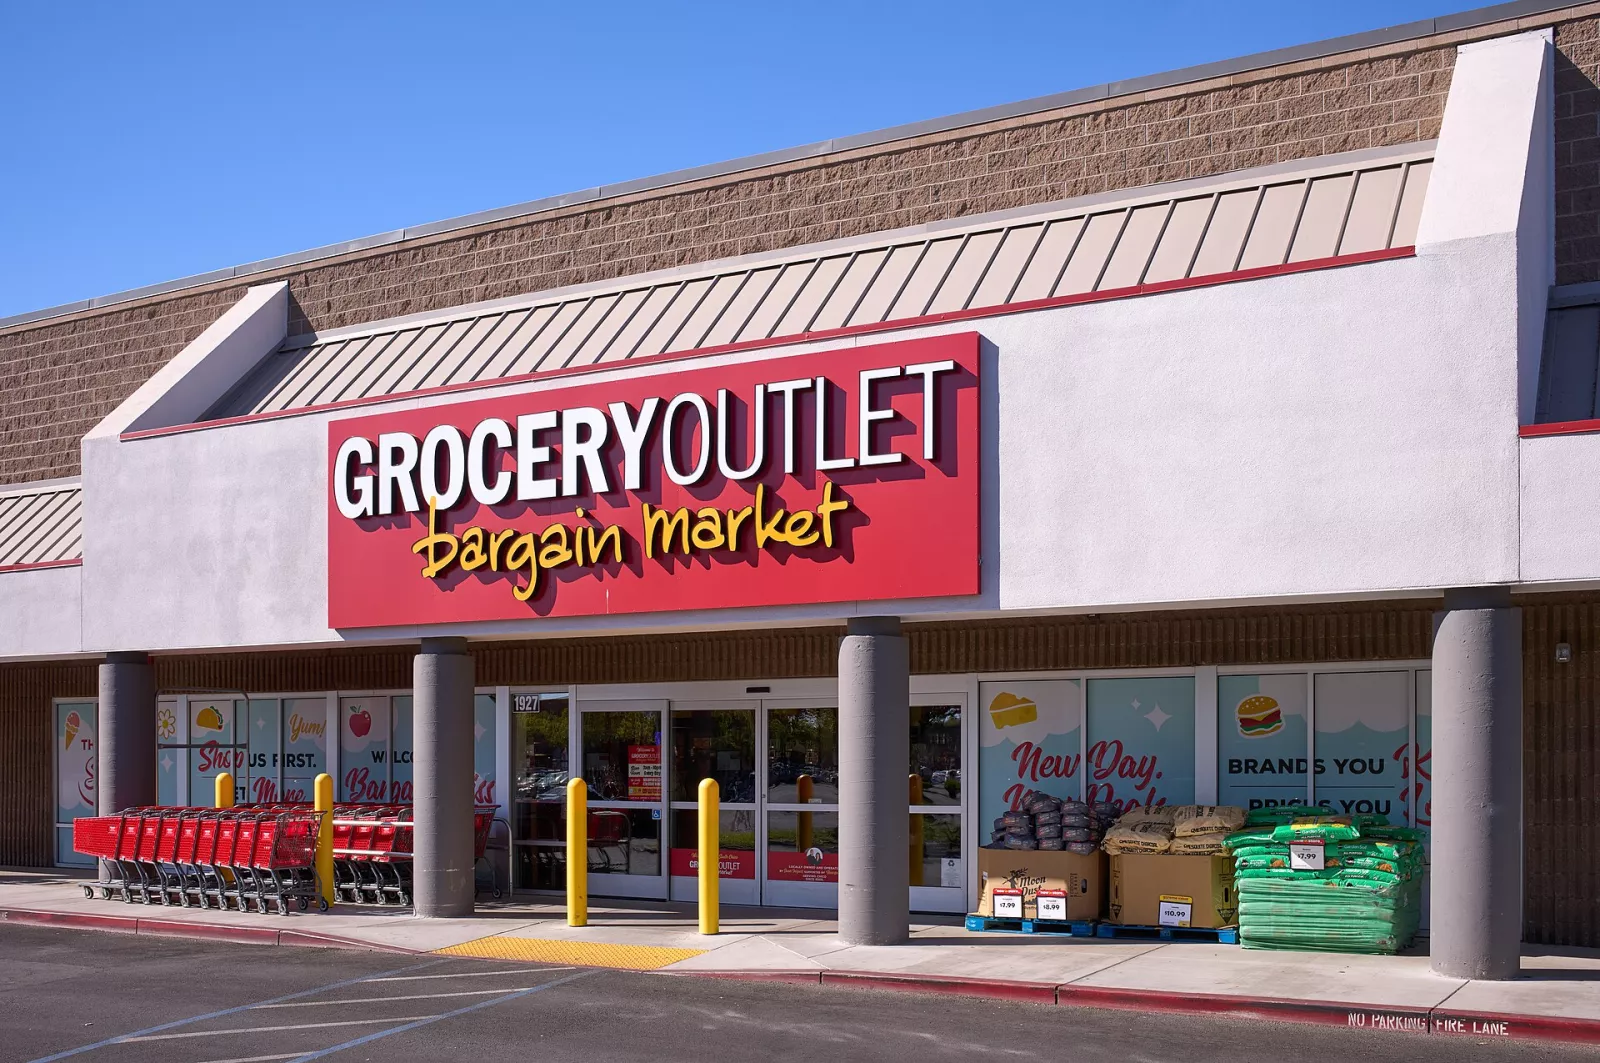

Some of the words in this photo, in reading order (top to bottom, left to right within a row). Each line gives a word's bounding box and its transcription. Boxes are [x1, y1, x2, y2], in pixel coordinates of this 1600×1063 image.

[411, 495, 623, 602] bargain
[642, 481, 850, 561] market
[514, 694, 539, 711] 1927
[288, 713, 328, 742] Yum!
[248, 753, 268, 768] US
[272, 752, 318, 769] FIRST.
[1010, 740, 1081, 783] New
[1087, 739, 1163, 791] Day.
[1228, 757, 1327, 775] BRANDS
[1332, 757, 1386, 775] YOU
[1339, 799, 1391, 816] YOU
[1019, 876, 1047, 888] Moon
[1164, 910, 1186, 918] $10.99
[1347, 1012, 1366, 1027] NO
[1371, 1013, 1427, 1031] PARKING
[1436, 1018, 1467, 1034] FIRE
[1472, 1021, 1510, 1036] LANE
